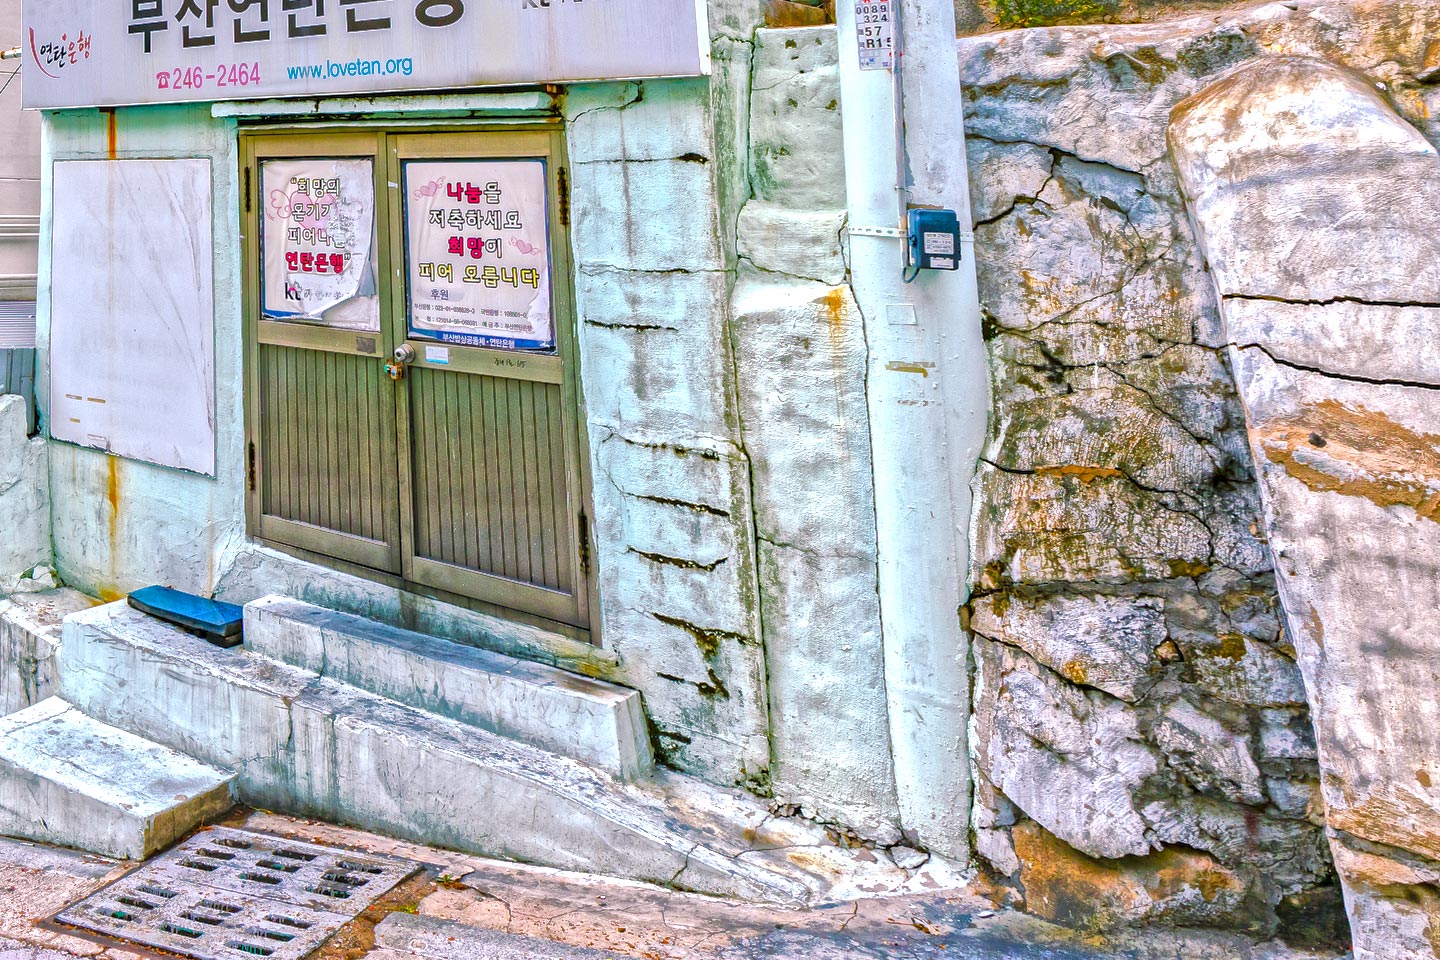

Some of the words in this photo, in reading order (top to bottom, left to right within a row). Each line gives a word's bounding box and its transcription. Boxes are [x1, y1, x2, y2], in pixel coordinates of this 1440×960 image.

[864, 25, 882, 37] 57
[40, 30, 91, 68] 연탄은행
[172, 62, 260, 89] 246-2464
[287, 57, 412, 80] www.lovetan.org
[446, 182, 501, 204] 나눔을
[429, 209, 522, 231] 저축하세요
[447, 236, 502, 259] 희망이
[419, 262, 453, 283] 피어
[463, 265, 539, 289] 오릅니다
[430, 289, 449, 300] 후원
